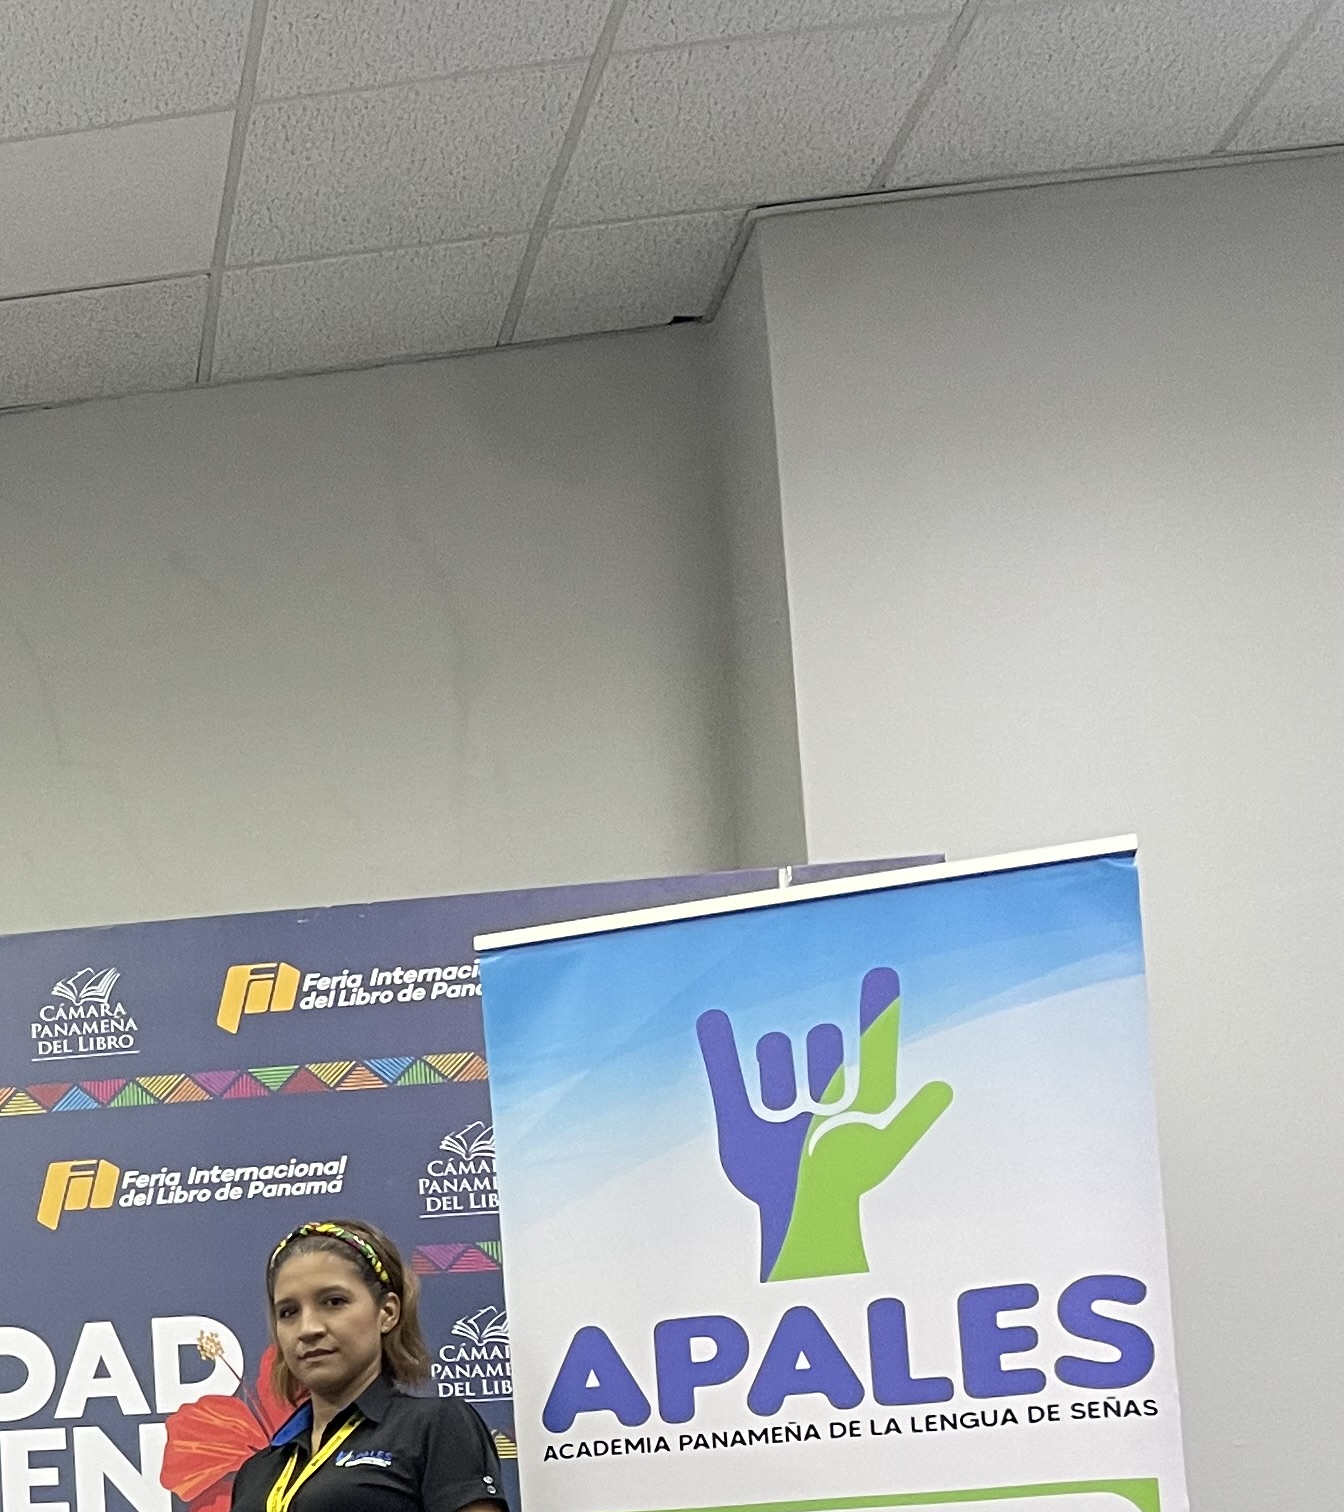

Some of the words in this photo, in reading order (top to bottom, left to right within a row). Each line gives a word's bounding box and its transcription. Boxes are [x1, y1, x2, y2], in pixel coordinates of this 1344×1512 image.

[302, 969, 363, 993] Feria
[299, 989, 336, 1010] del
[337, 987, 394, 1007] Libro
[396, 983, 427, 1002] de
[39, 999, 127, 1022] CÁMARA
[31, 1013, 138, 1039] PANAMEÑA
[37, 1038, 73, 1055] DEL
[78, 1034, 134, 1052] LIBRO
[121, 1167, 181, 1191] Feria
[187, 1155, 348, 1185] Internacional
[427, 1158, 496, 1176] CÁMA
[118, 1187, 155, 1208] del
[156, 1185, 212, 1205] Libro
[214, 1182, 243, 1201] de
[247, 1174, 344, 1199] Panamá
[419, 1177, 499, 1195] PANAM
[425, 1195, 464, 1212] DEL
[470, 1193, 499, 1209] LIB
[439, 1345, 510, 1362] CÁMA
[541, 1273, 1156, 1434] APALES
[437, 1381, 476, 1398] DEL
[482, 1379, 513, 1394] LIB
[543, 1436, 671, 1462] ACADEMIA
[679, 1421, 822, 1452] PANAMEÑA
[829, 1420, 862, 1439] DE
[870, 1417, 903, 1436] LA
[910, 1408, 1019, 1433] LENGUA
[1027, 1403, 1061, 1424] DE
[1070, 1396, 1159, 1420] SEÑAS
